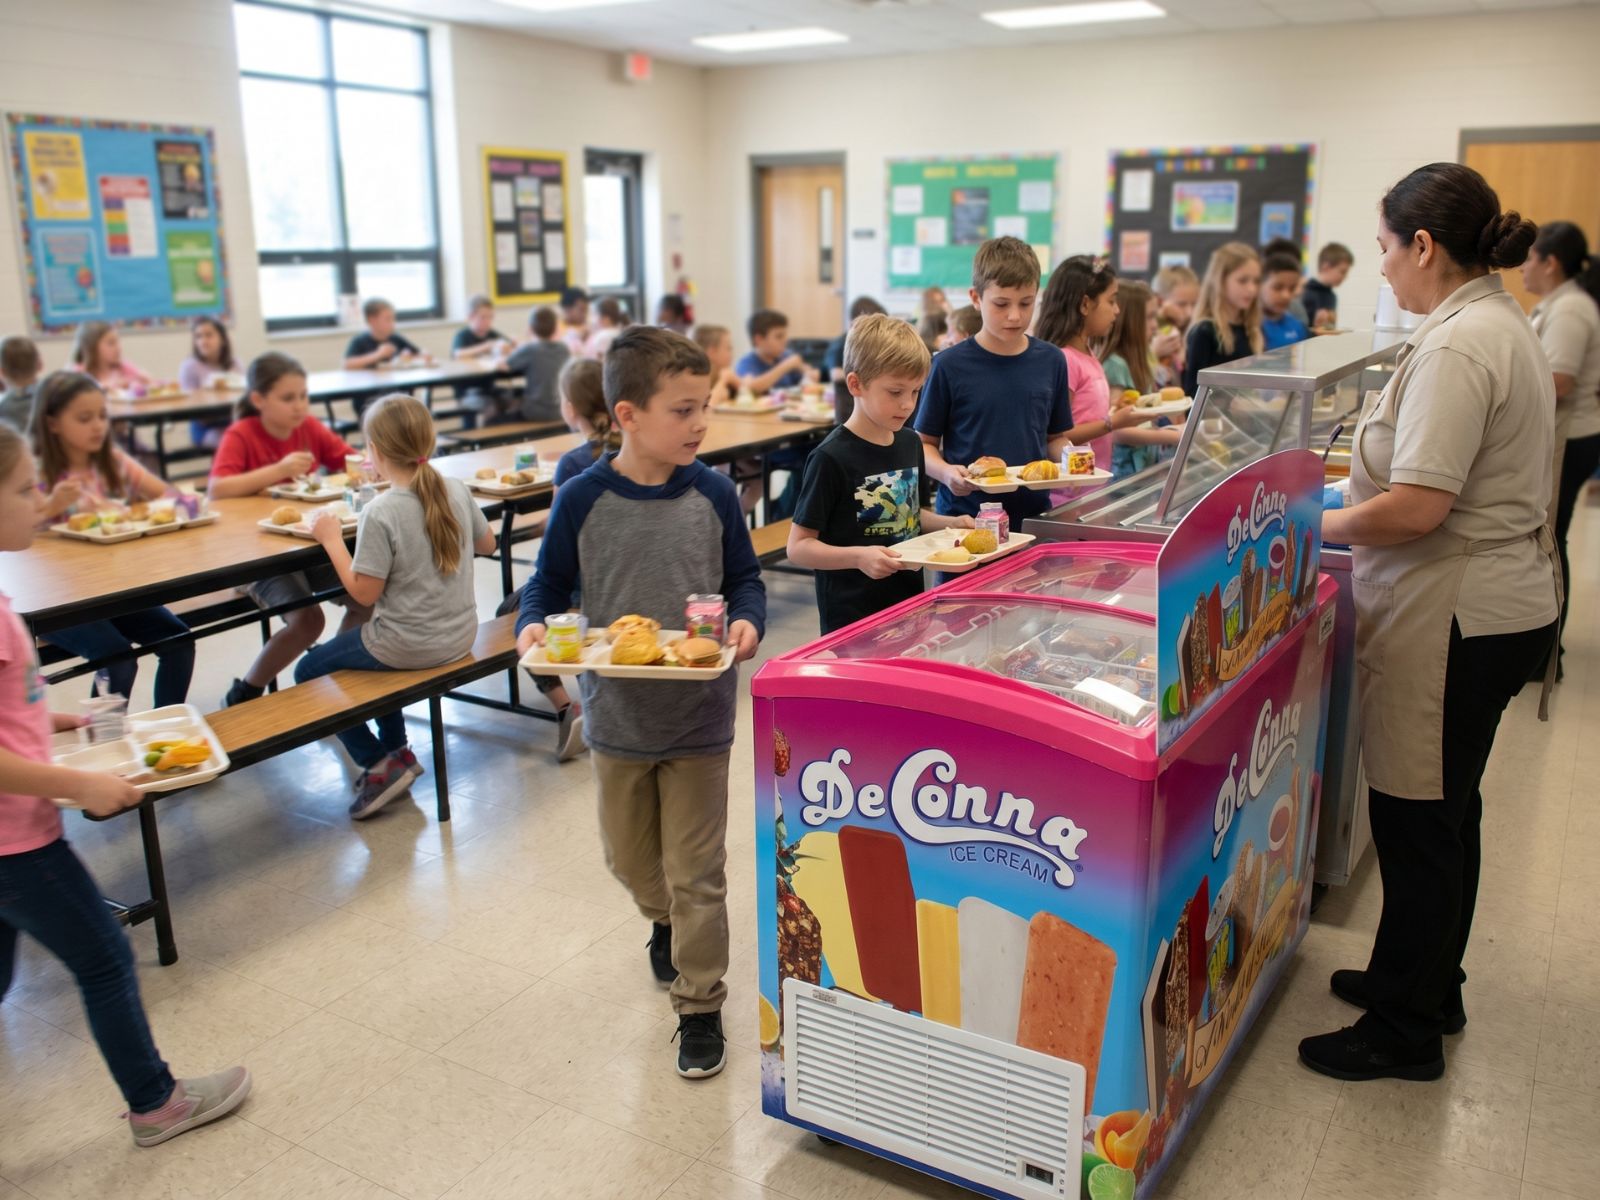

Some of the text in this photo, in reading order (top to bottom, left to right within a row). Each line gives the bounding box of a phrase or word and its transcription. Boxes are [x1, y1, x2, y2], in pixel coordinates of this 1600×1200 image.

[1227, 481, 1287, 564] DeConna
[799, 748, 1088, 889] DeConna
[949, 845, 1049, 884] ICE CREAM
